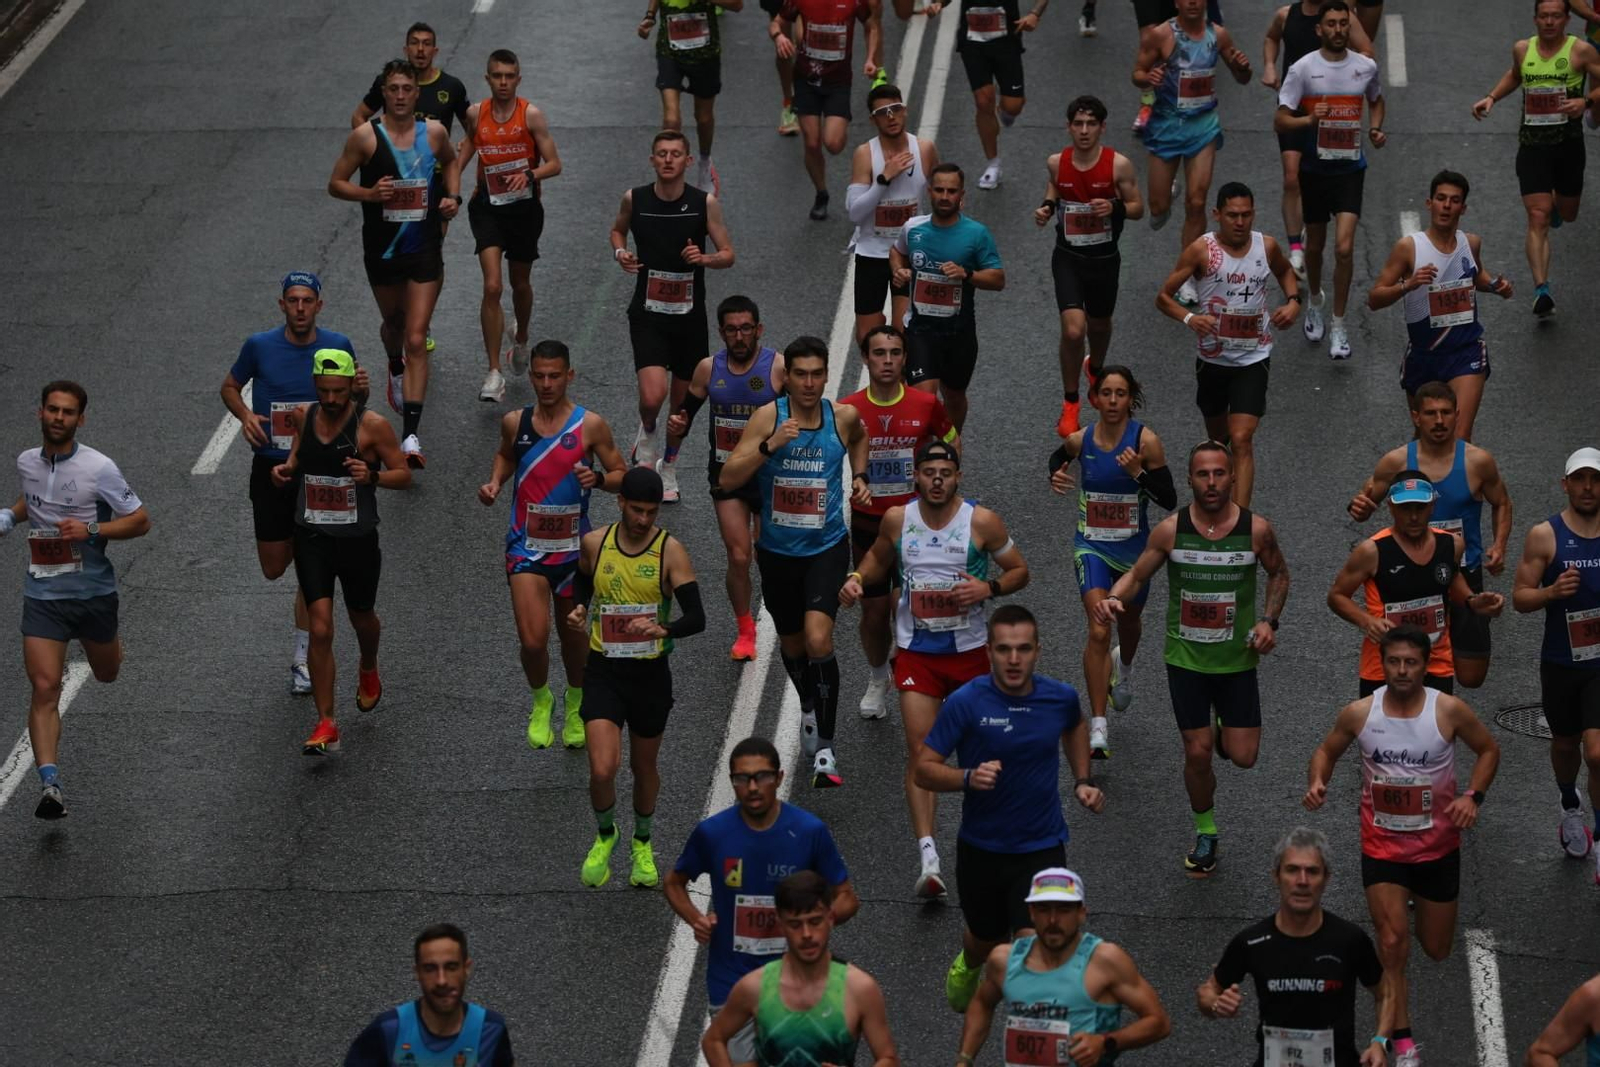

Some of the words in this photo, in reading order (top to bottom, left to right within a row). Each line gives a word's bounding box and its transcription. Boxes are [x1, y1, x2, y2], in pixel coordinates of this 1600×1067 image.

[1226, 272, 1246, 284] VIDA
[658, 282, 681, 295] 238
[791, 447, 823, 458] ITALIA
[782, 459, 826, 474] SIMONE
[868, 462, 902, 477] 1798
[310, 487, 342, 502] 1293
[781, 491, 814, 507] 1054
[1093, 505, 1126, 520] 1428
[1382, 749, 1429, 766] Salud
[1383, 789, 1411, 807] 661
[1016, 1034, 1046, 1055] 607
[1287, 1047, 1303, 1060] FIZ
